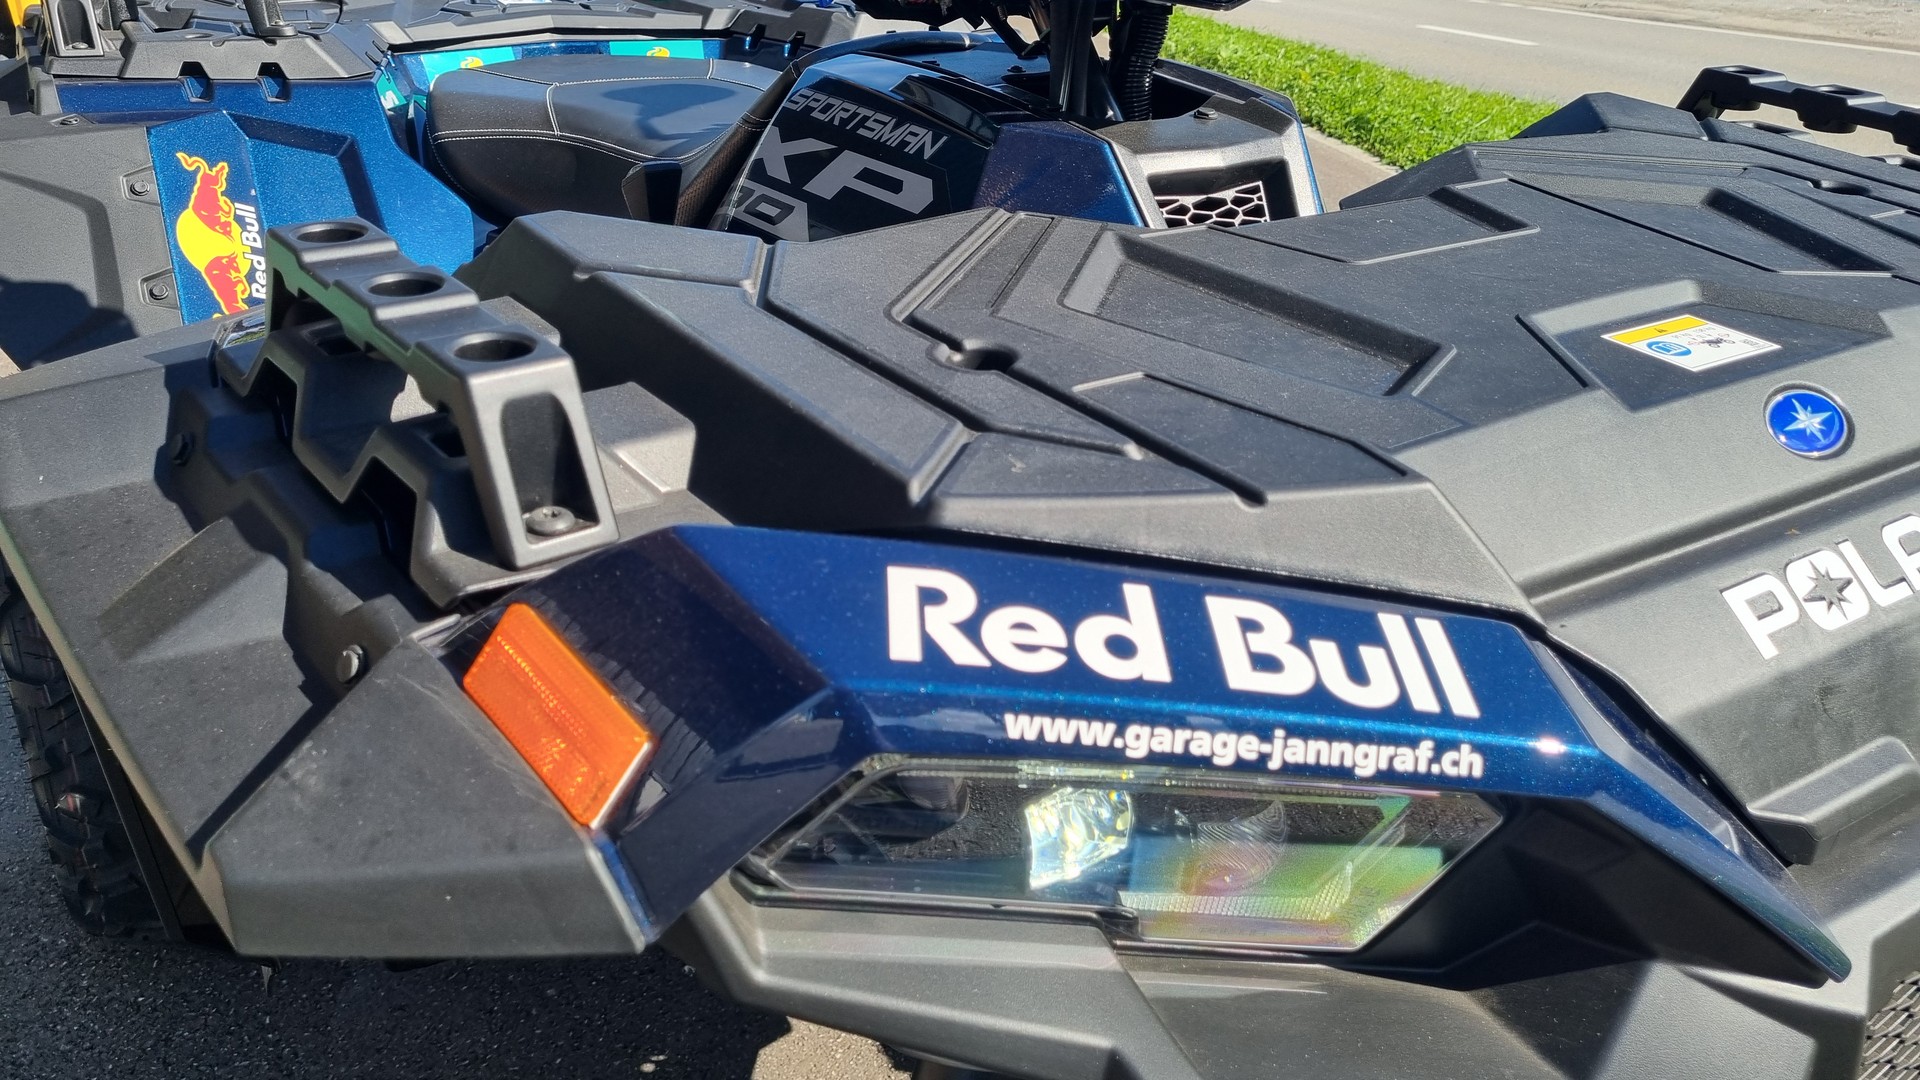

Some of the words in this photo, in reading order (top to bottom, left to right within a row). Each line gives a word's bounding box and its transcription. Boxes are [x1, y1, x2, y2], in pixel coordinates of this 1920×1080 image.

[784, 88, 948, 160] SPORTSMAN
[752, 126, 934, 214] XP
[234, 203, 263, 249] Bull
[886, 565, 1172, 683] Red
[1205, 595, 1481, 718] Bull
[1004, 712, 1484, 779] www.garage-janngraf.ch
